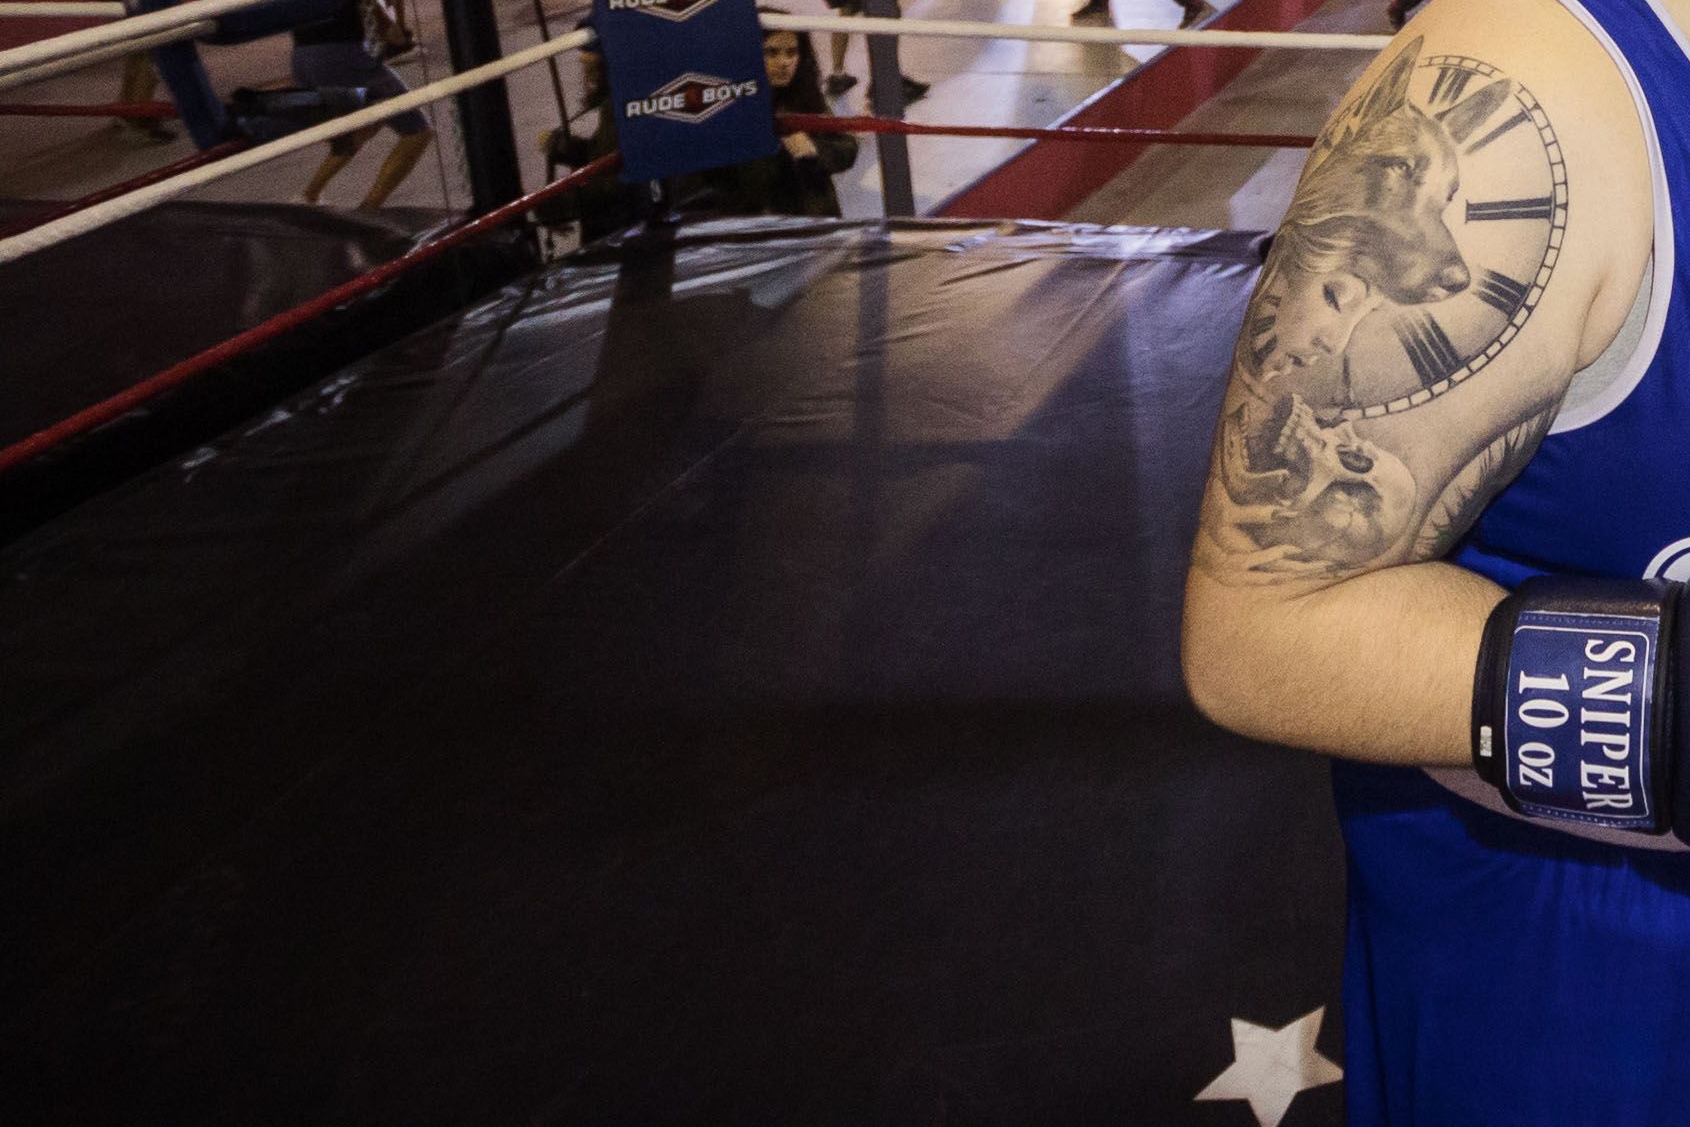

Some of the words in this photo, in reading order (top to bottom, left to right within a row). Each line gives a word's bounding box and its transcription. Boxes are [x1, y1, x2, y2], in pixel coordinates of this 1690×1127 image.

[627, 93, 685, 117] RUDE
[702, 80, 757, 103] BOYS
[1518, 670, 1570, 728] 10
[1580, 639, 1636, 809] SNIPER
